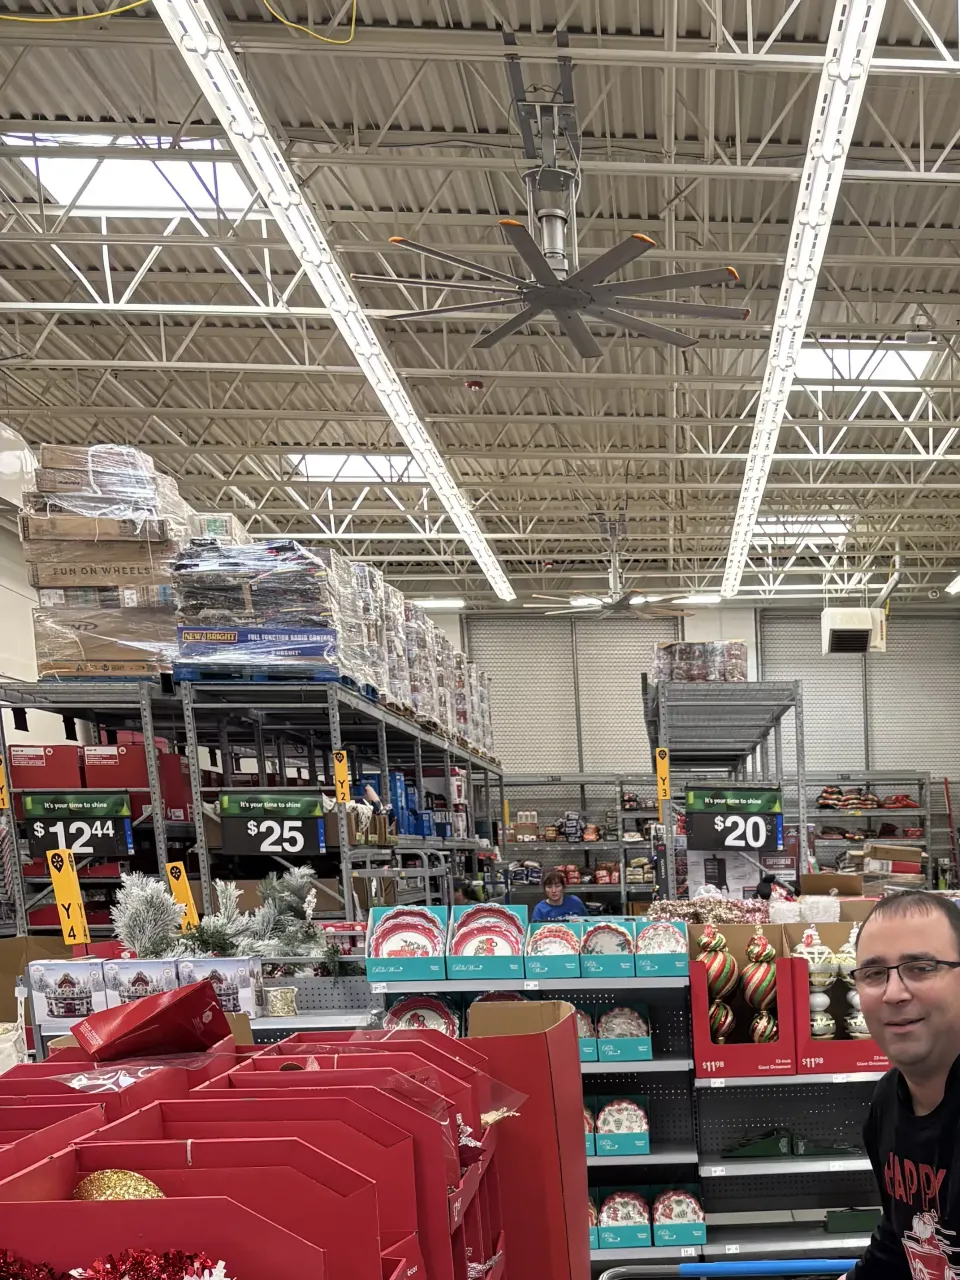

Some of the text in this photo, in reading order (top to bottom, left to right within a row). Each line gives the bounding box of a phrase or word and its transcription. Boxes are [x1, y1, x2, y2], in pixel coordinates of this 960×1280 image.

[53, 566, 150, 576] FUN ON WHEELS
[206, 632, 236, 641] BRIGHT
[339, 779, 346, 789] Y
[660, 776, 667, 785] Y
[341, 792, 347, 801] 2
[662, 788, 667, 797] 3
[240, 801, 248, 809] It's
[264, 801, 278, 809] time
[714, 798, 726, 806] your
[747, 797, 762, 805] shine
[53, 803, 68, 811] your
[714, 815, 767, 848] $20
[247, 820, 305, 853] $25
[60, 902, 72, 920] Y
[67, 925, 77, 940] 4
[884, 1151, 948, 1217] HAPPY
